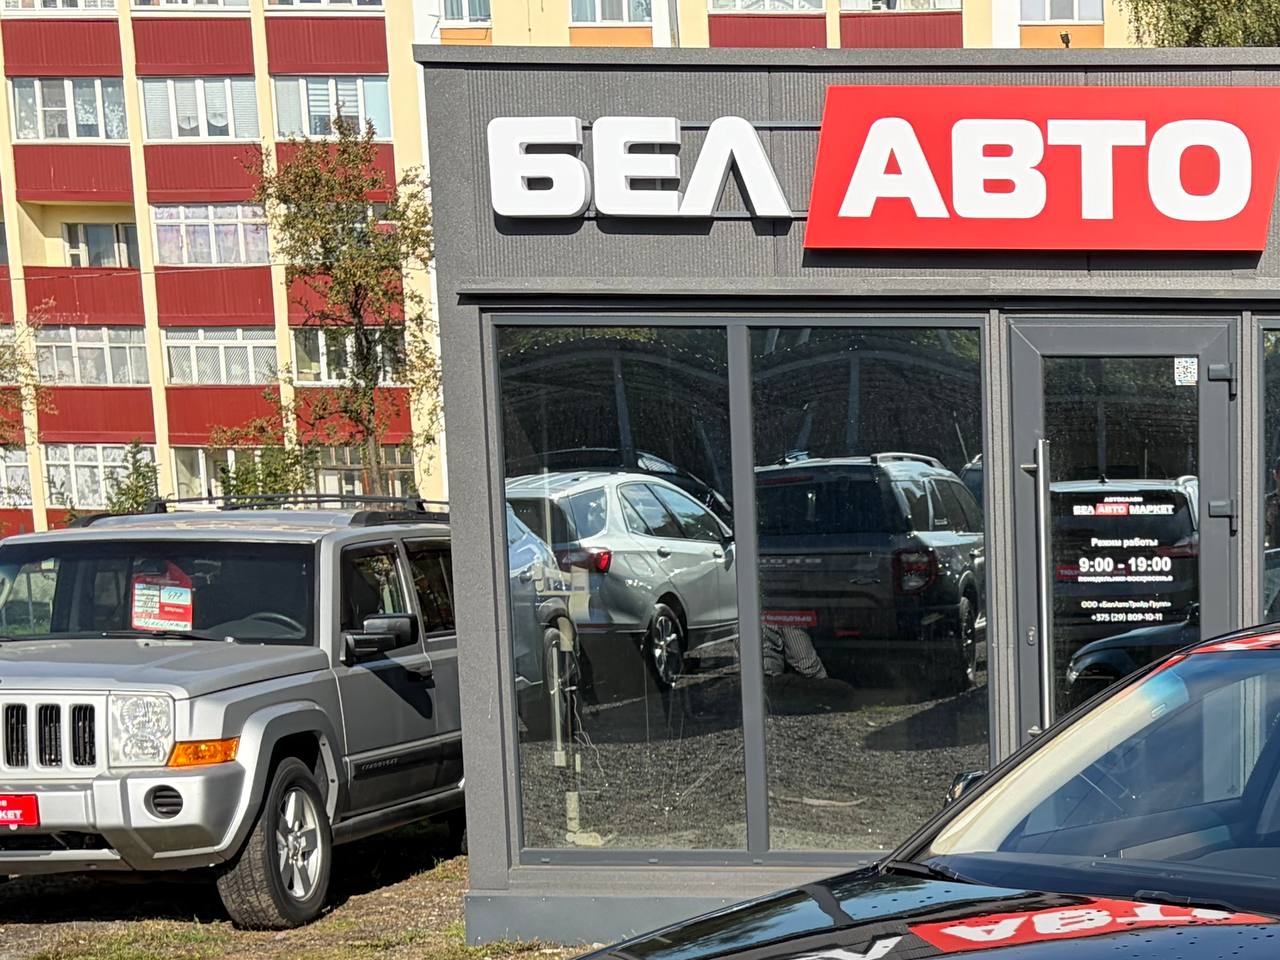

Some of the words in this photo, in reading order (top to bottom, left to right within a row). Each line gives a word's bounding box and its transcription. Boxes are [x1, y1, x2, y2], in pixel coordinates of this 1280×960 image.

[487, 115, 792, 218] БЕЛ
[837, 116, 1253, 223] АВТО
[1090, 537, 1121, 546] Режим
[1123, 537, 1158, 548] работы
[1079, 557, 1113, 572] 9:00
[1128, 556, 1171, 571] 19:00
[1090, 613, 1109, 621] +375
[1110, 612, 1126, 621] (29)
[1127, 612, 1163, 621] 809-10-11
